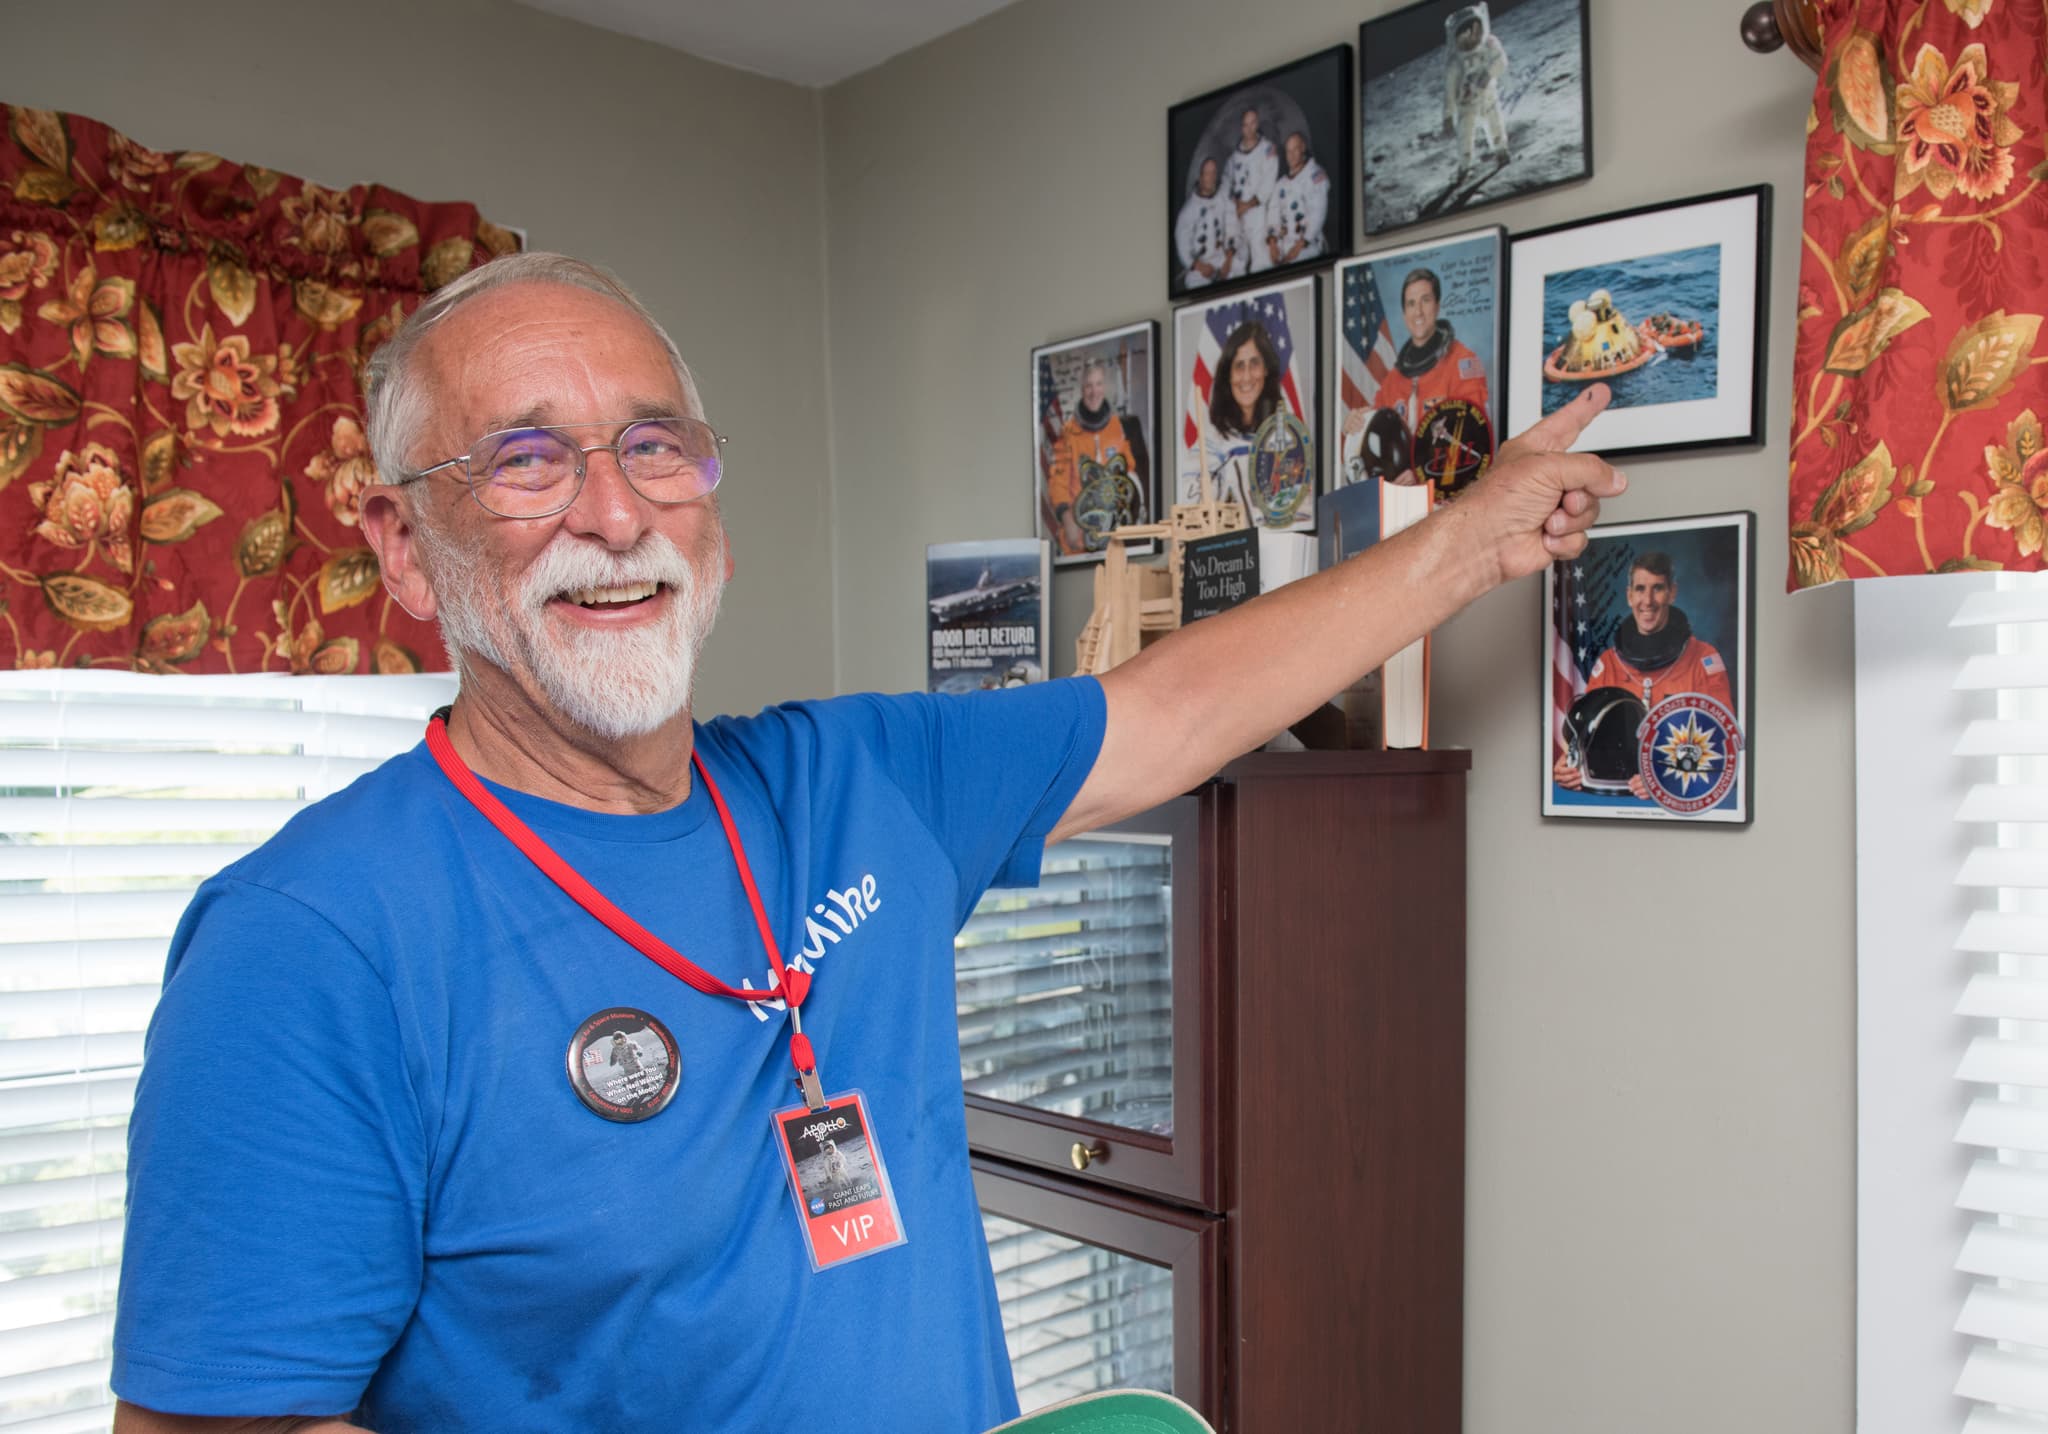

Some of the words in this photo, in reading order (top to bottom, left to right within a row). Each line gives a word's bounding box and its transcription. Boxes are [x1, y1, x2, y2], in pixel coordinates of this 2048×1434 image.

[1189, 559, 1206, 578] No
[1208, 556, 1243, 575] Dream
[1245, 551, 1255, 570] Is
[1197, 580, 1217, 601] Too
[1219, 574, 1246, 602] High
[991, 627, 1035, 645] RETURN
[1658, 698, 1687, 715] COATS
[606, 1086, 626, 1097] When
[626, 1080, 640, 1090] Neil
[640, 1073, 663, 1085] Walked
[608, 1077, 628, 1087] Where
[629, 1071, 645, 1080] were
[626, 1091, 638, 1101] the
[801, 1117, 848, 1138] APOLLO
[833, 1188, 853, 1200] GIANT
[853, 1183, 871, 1194] LEAPS
[828, 1198, 843, 1209] PAST
[844, 1194, 859, 1204] AND
[831, 1214, 875, 1247] VIP
